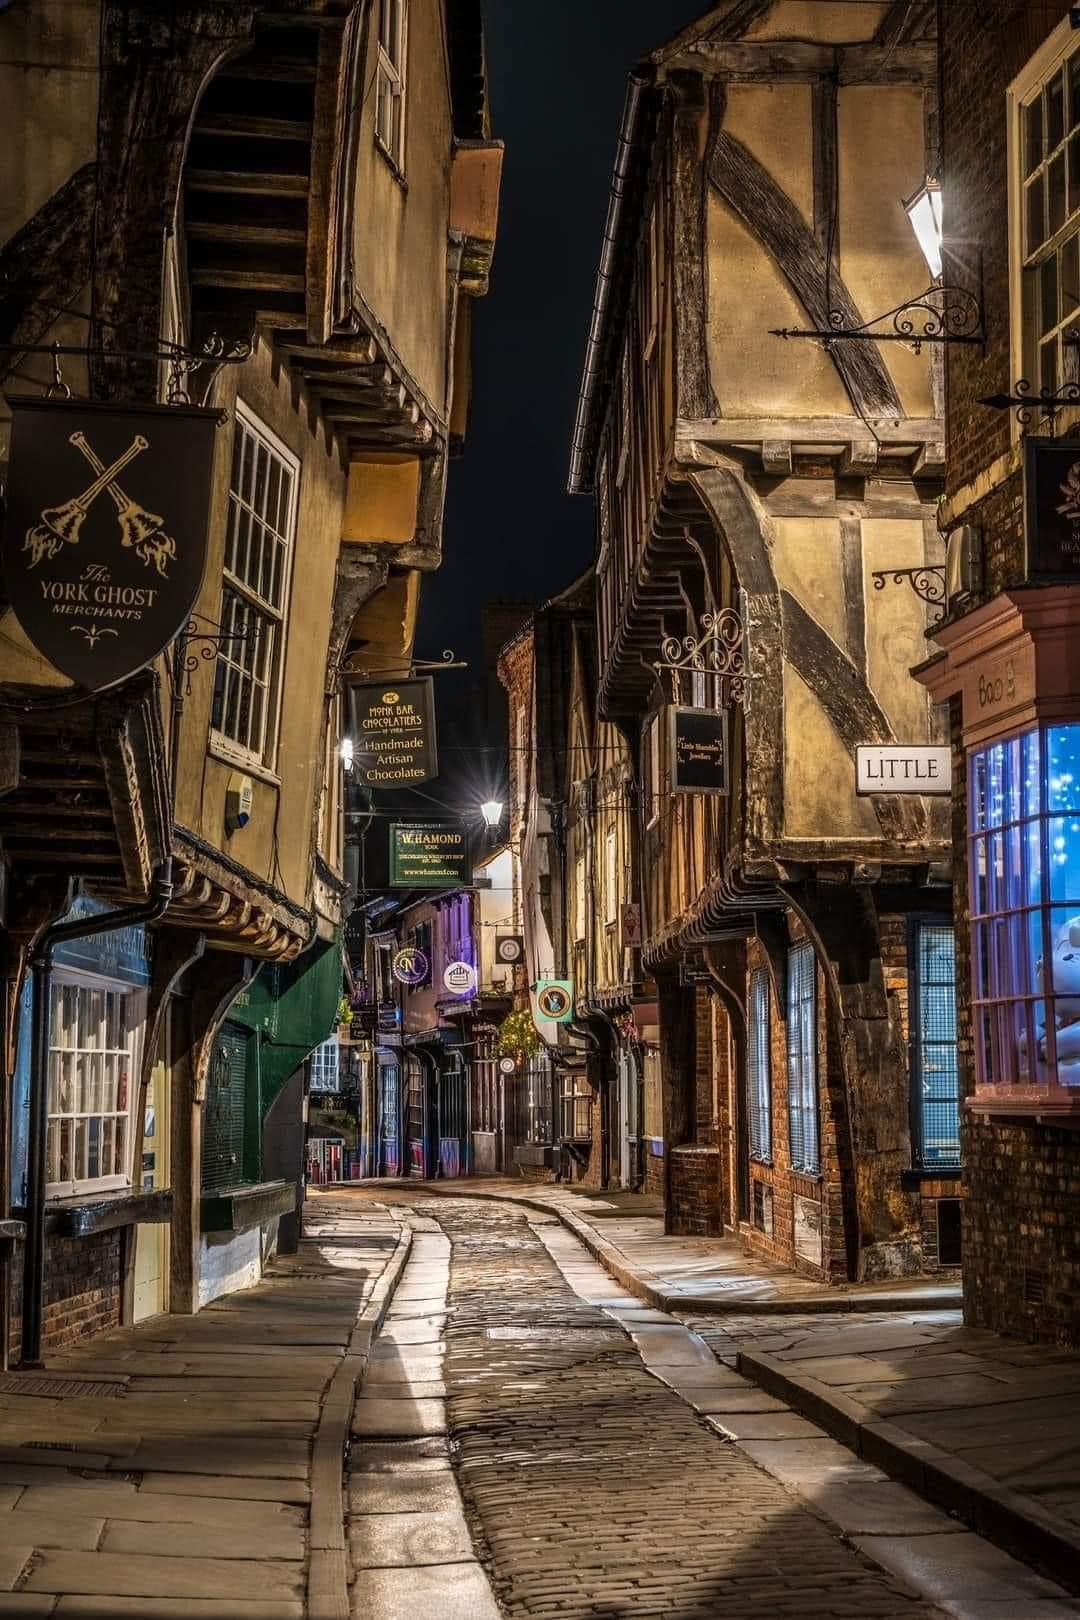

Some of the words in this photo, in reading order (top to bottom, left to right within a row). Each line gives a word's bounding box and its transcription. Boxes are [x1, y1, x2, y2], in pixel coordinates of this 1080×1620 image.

[80, 564, 112, 583] The
[41, 580, 90, 602] YORK
[94, 585, 157, 607] GHOST
[52, 604, 142, 621] MERCHANTS
[369, 706, 394, 718] MONK
[396, 705, 414, 716] BAR
[362, 715, 422, 729] CHOCOLATIERS
[365, 737, 424, 751] Handmade
[377, 754, 414, 765] Artisan
[366, 767, 425, 781] Chocolates
[867, 759, 939, 779] LITTLE
